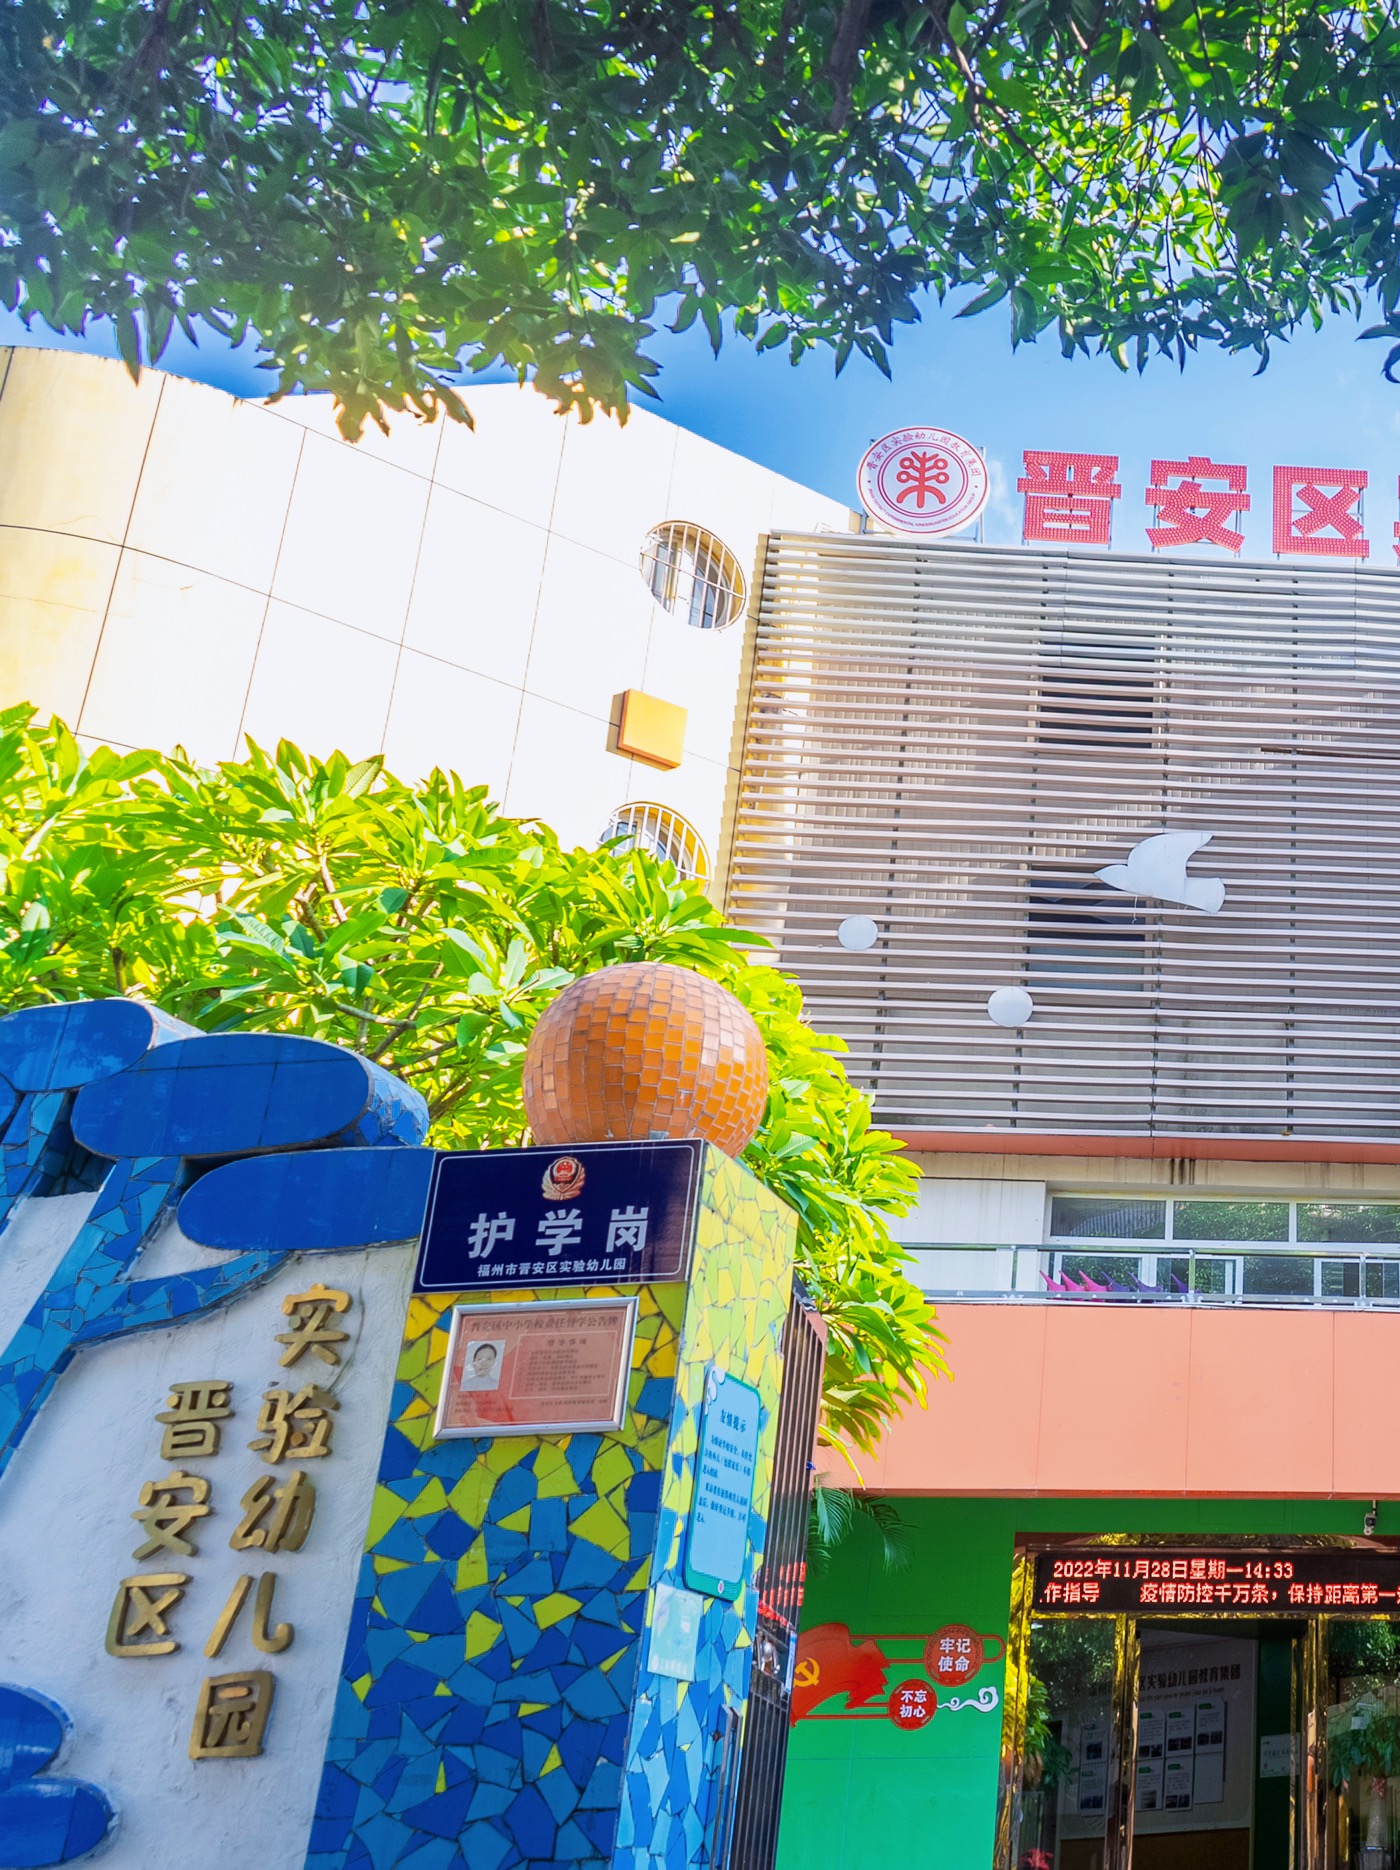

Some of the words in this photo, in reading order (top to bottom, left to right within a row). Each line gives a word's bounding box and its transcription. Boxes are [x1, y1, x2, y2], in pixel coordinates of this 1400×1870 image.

[915, 518, 949, 527] KINDERGARTEN
[467, 1205, 649, 1259] 护学岗
[477, 1258, 626, 1277] 福州市晋安区实验幼儿园
[105, 1379, 234, 1658] 晋安区
[188, 1282, 351, 1761] 实验幼儿园
[1039, 1582, 1100, 1604] 作指导
[939, 1637, 971, 1654] 牢记
[938, 1655, 970, 1672] 使命
[900, 1689, 927, 1703] 不忘
[899, 1704, 926, 1718] 初心
